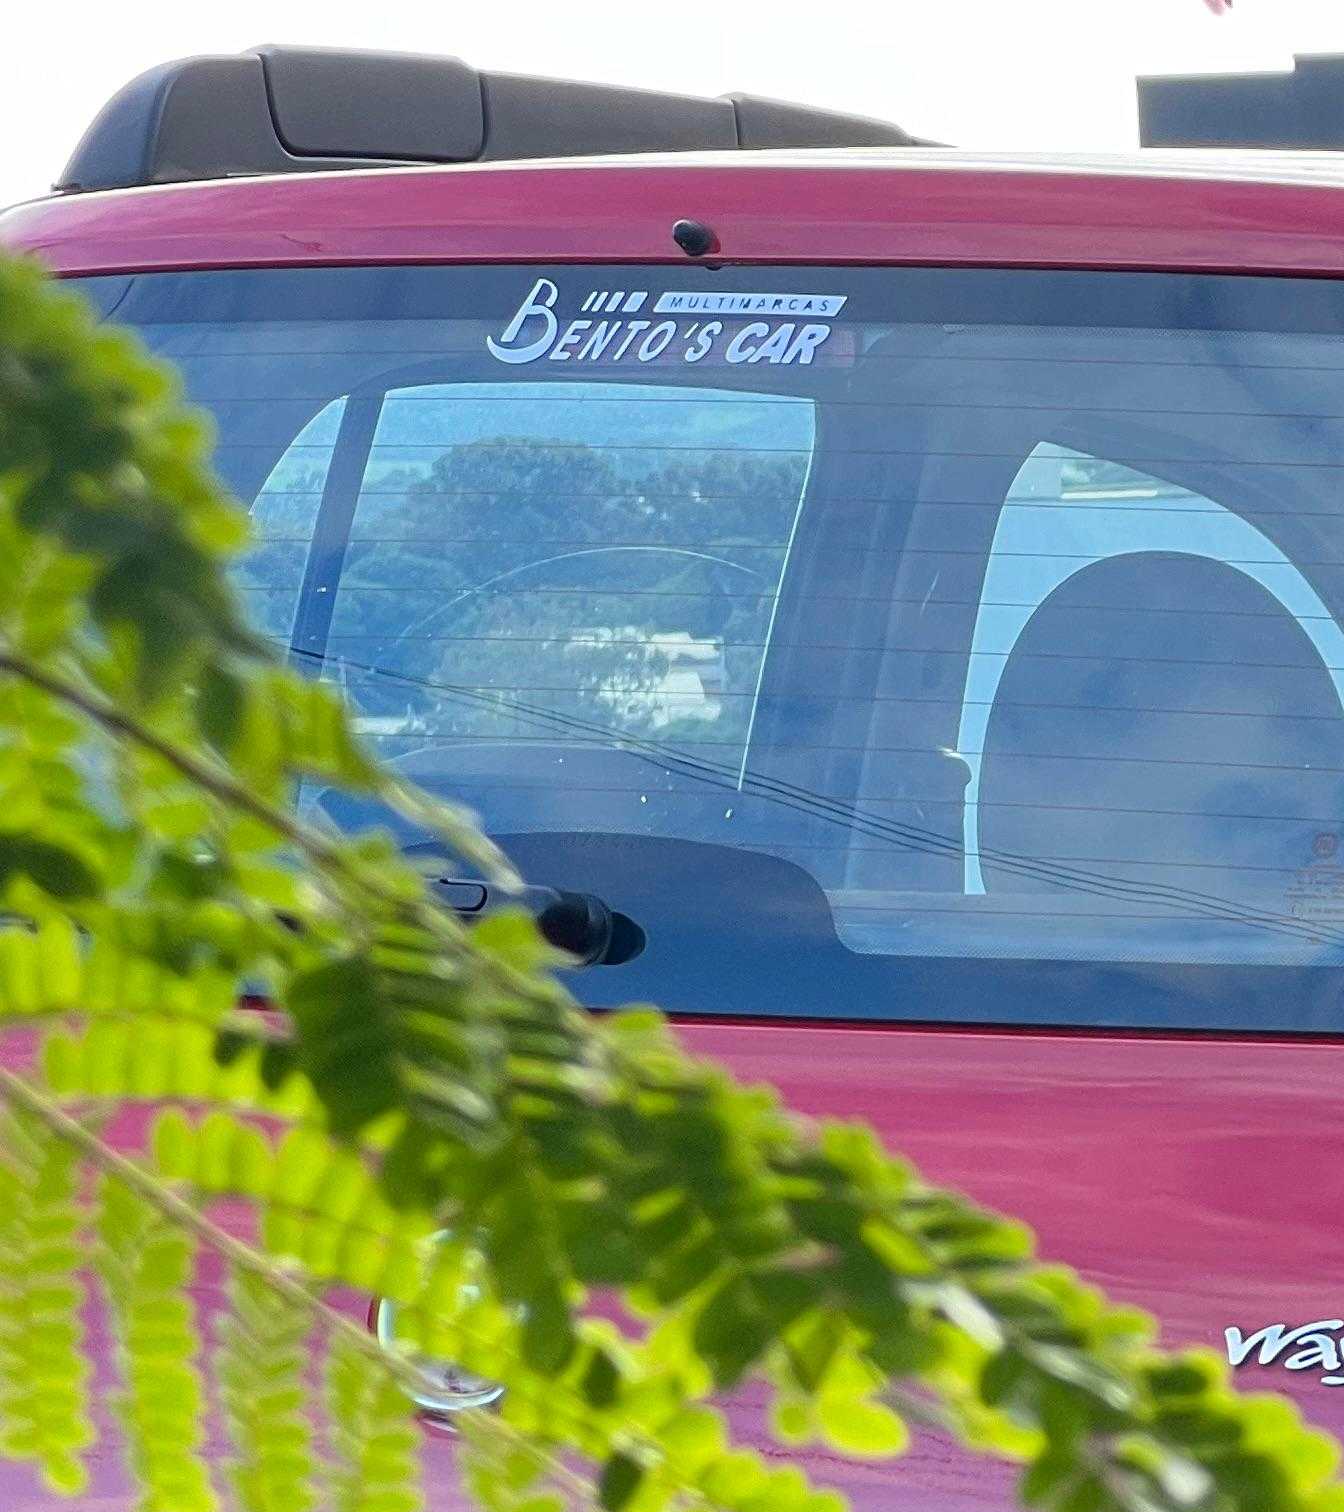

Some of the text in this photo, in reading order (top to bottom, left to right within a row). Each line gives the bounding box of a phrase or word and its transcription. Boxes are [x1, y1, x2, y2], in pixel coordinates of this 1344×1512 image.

[486, 277, 831, 364] BENTO'S CAR
[669, 296, 830, 312] MULTIMARCAS
